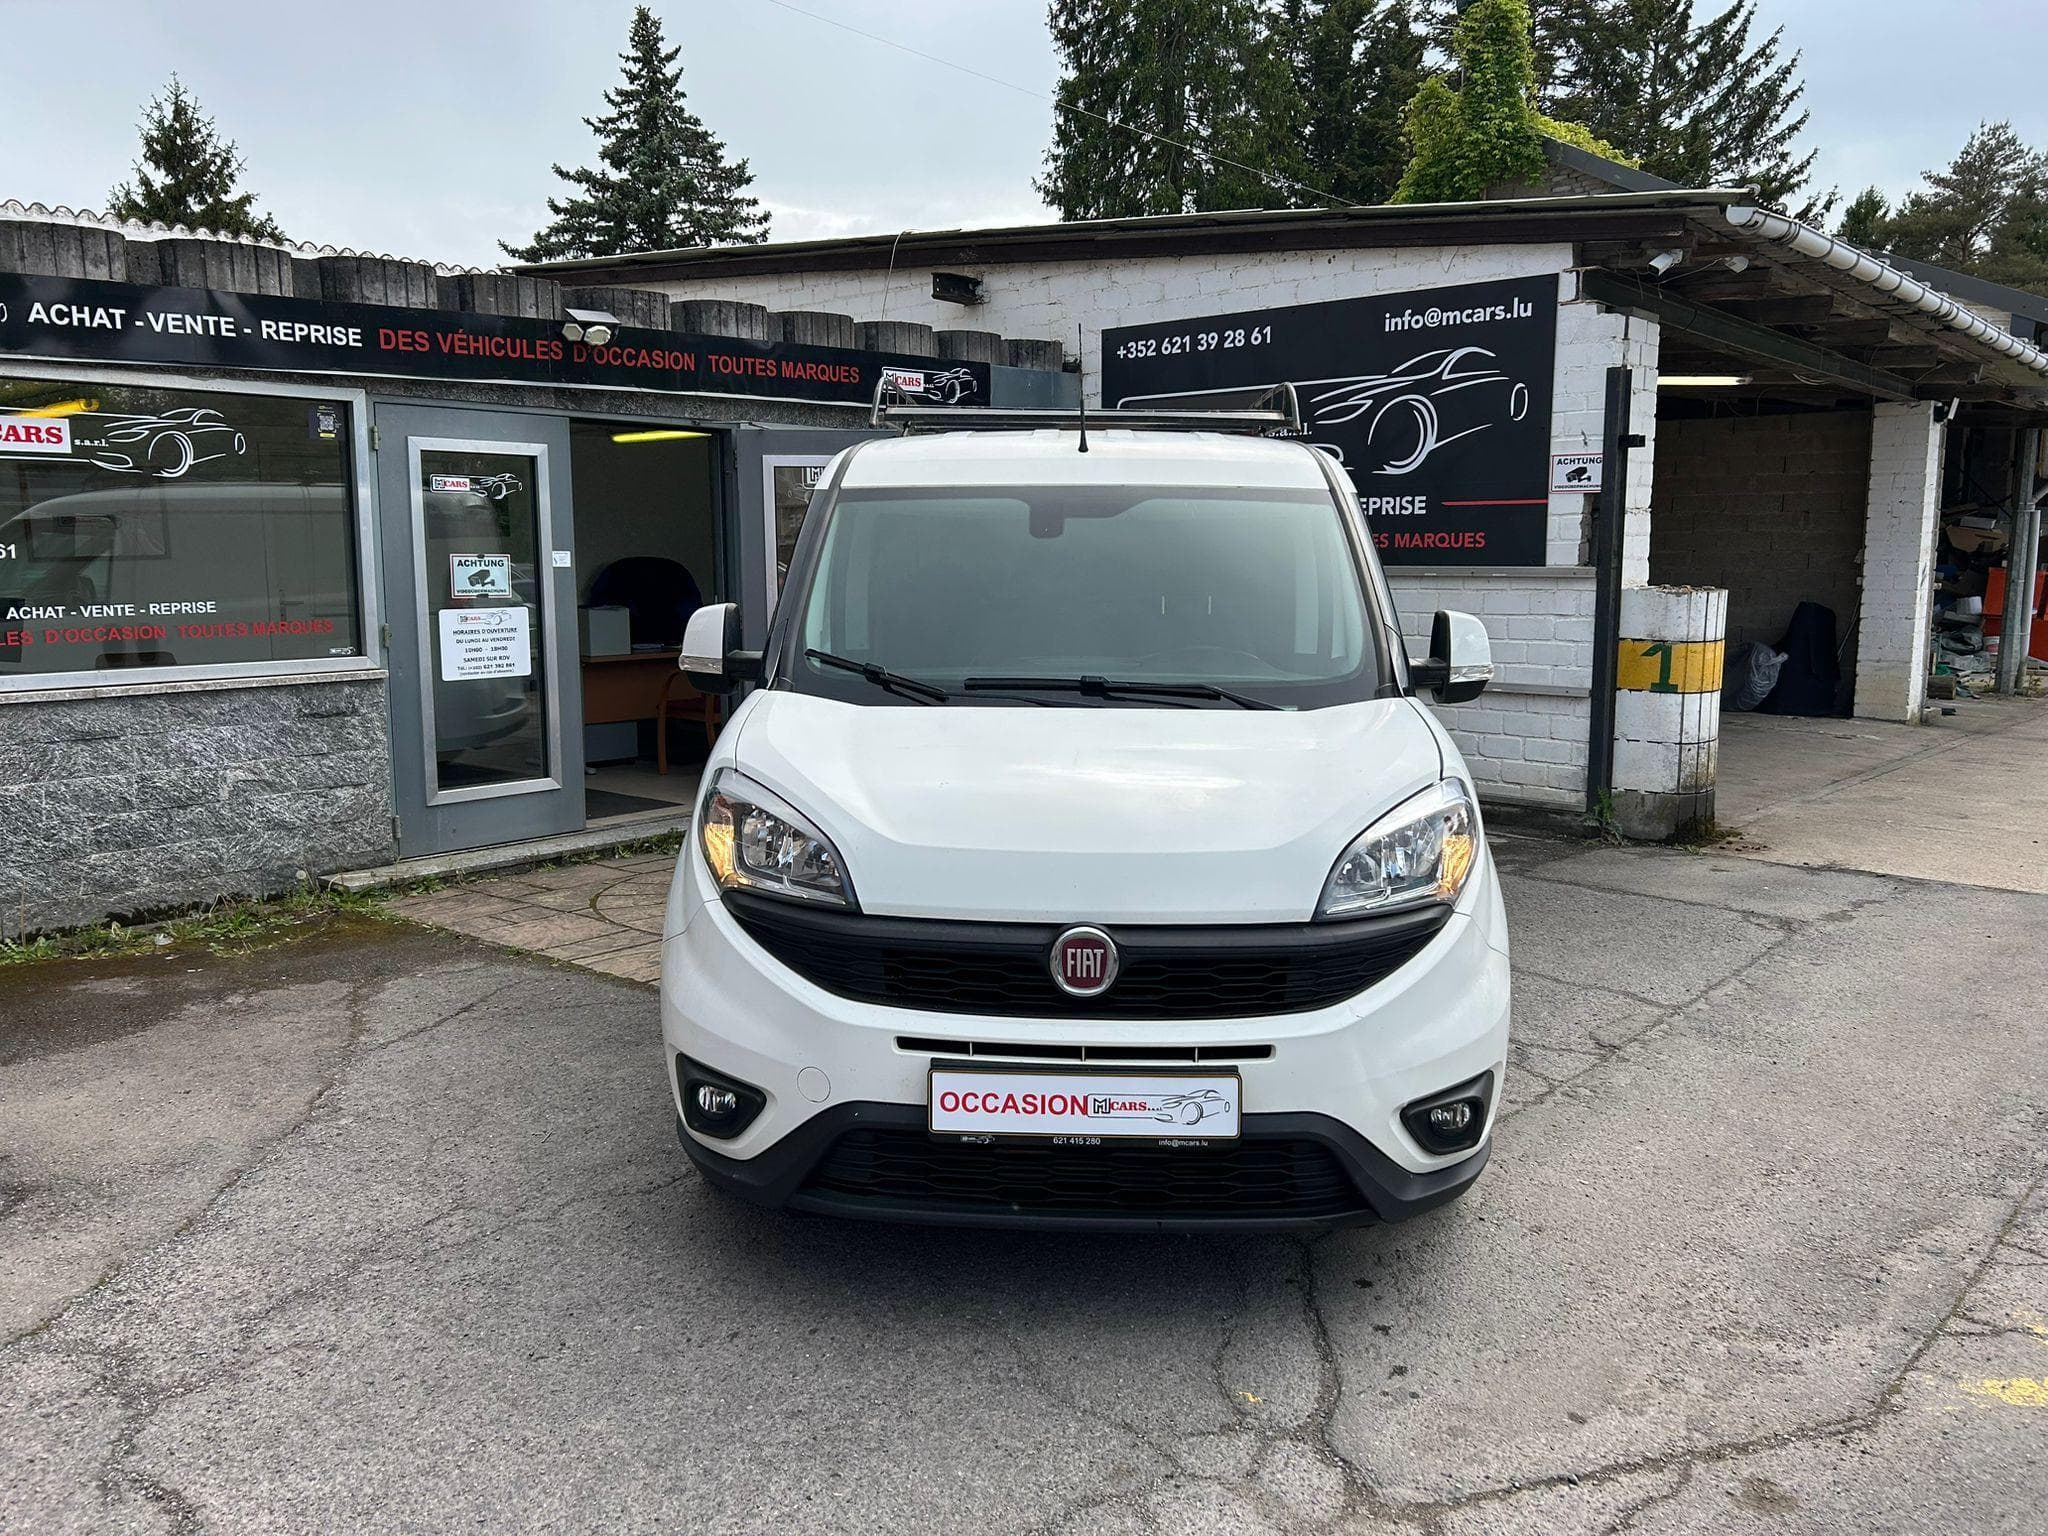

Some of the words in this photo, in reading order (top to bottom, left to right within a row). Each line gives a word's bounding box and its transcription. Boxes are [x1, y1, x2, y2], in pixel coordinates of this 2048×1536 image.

[1384, 297, 1533, 332] info@mcars.lu
[28, 302, 126, 330] ACHAT
[146, 312, 236, 338] VENTE
[261, 320, 363, 347] REPRISE
[378, 328, 430, 352] DES
[436, 329, 563, 361] VÉHICULES
[573, 343, 695, 371] D'OCCASION
[708, 355, 776, 377] TOUTES
[781, 361, 860, 384] MARQUES
[1116, 339, 1157, 359] +352
[1161, 335, 1191, 355] 621
[1197, 332, 1219, 351] 39
[1223, 329, 1245, 348] 28
[1250, 326, 1272, 345] 61
[0, 424, 63, 445] ARS
[74, 438, 109, 447] s.a.r.l.
[1556, 457, 1602, 466] ACHTUNG
[1360, 495, 1427, 516] EPRISE
[1394, 531, 1486, 548] MARQUES
[457, 559, 504, 568] ACHTUNG
[6, 606, 66, 620] ACHAT
[80, 604, 136, 618] VENTE
[149, 601, 216, 616] REPRISE
[45, 625, 166, 644] D'OCCASION
[176, 622, 248, 639] TOUTES
[252, 619, 334, 636] MARQUES
[1641, 643, 1678, 692] 1
[1067, 948, 1104, 978] FIAT
[939, 1091, 1088, 1116] OCCASION
[1053, 1137, 1067, 1145] 621
[1158, 1139, 1209, 1148] info@mcars.lu
